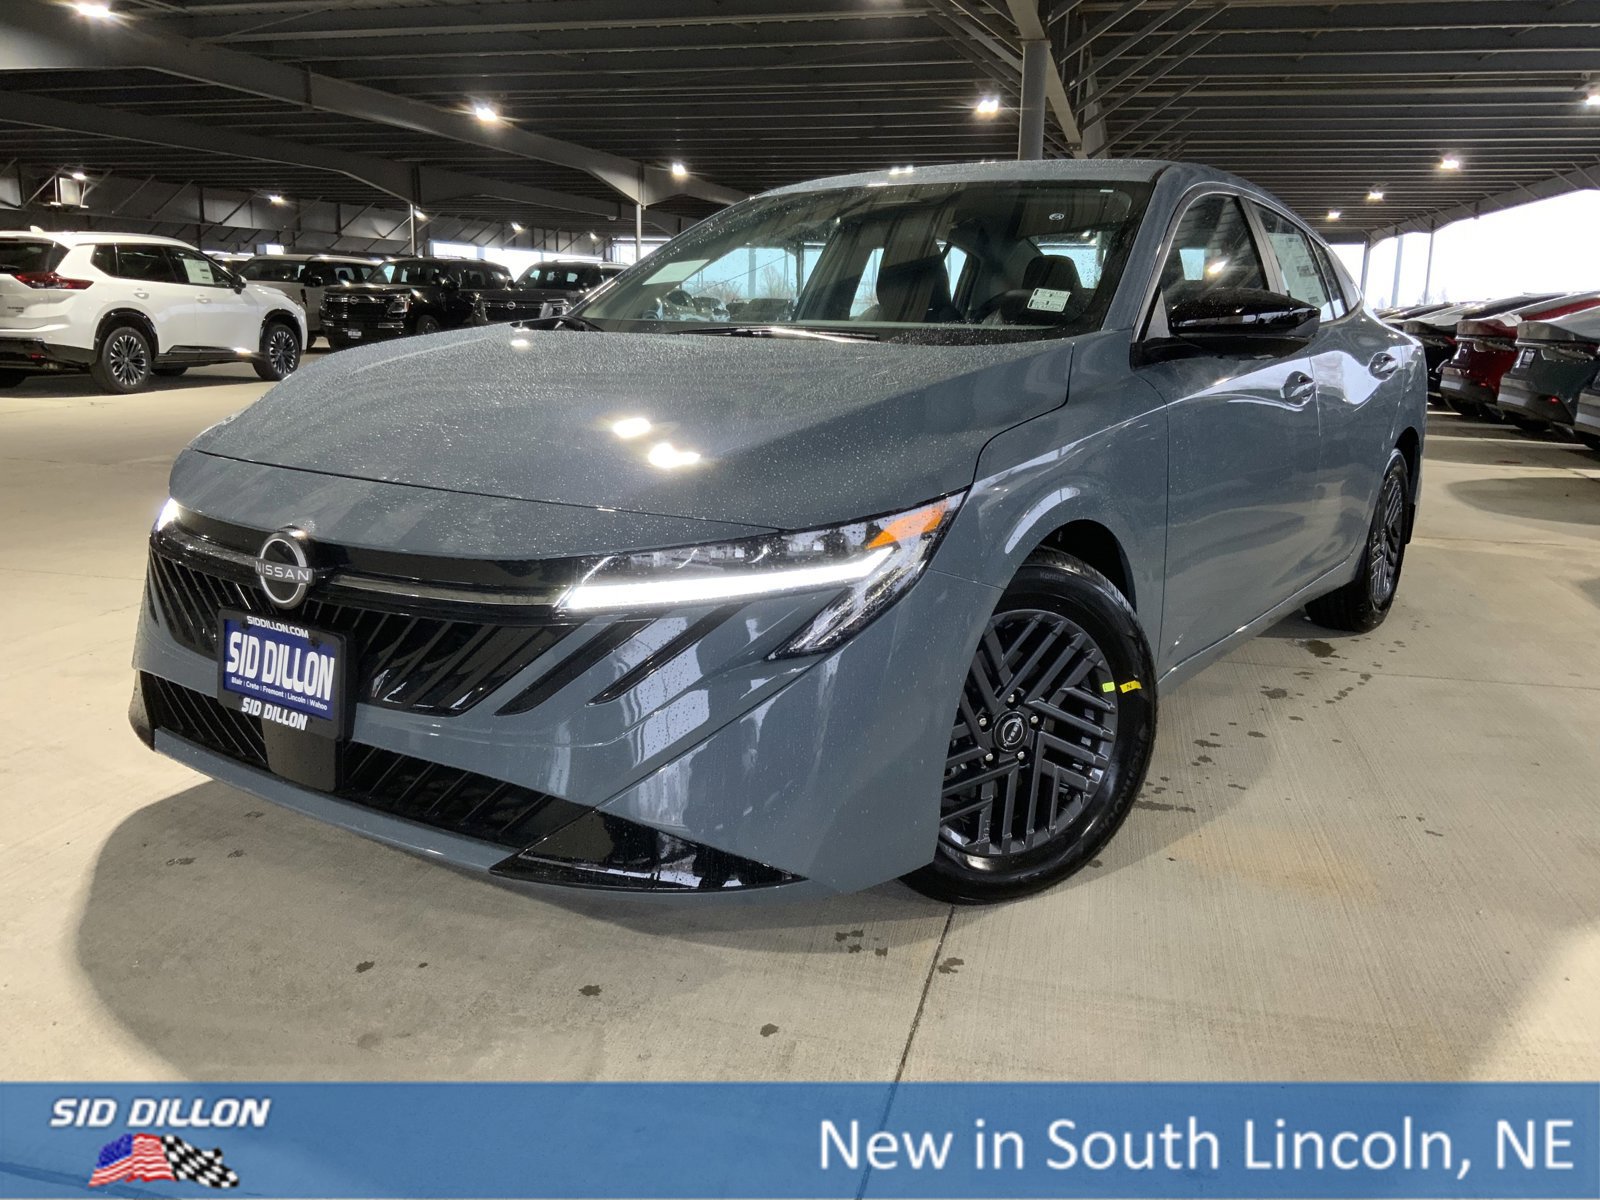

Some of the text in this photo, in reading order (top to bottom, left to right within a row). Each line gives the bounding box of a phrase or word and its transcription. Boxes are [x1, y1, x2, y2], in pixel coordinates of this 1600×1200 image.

[255, 561, 310, 581] NISSAN
[246, 615, 309, 638] SIDDILLON.COM
[226, 631, 335, 701] SID DILLON
[262, 685, 285, 698] Fremont
[287, 692, 306, 704] Lincoln
[309, 699, 328, 711] Wahoo
[241, 697, 308, 731] SID DILLON
